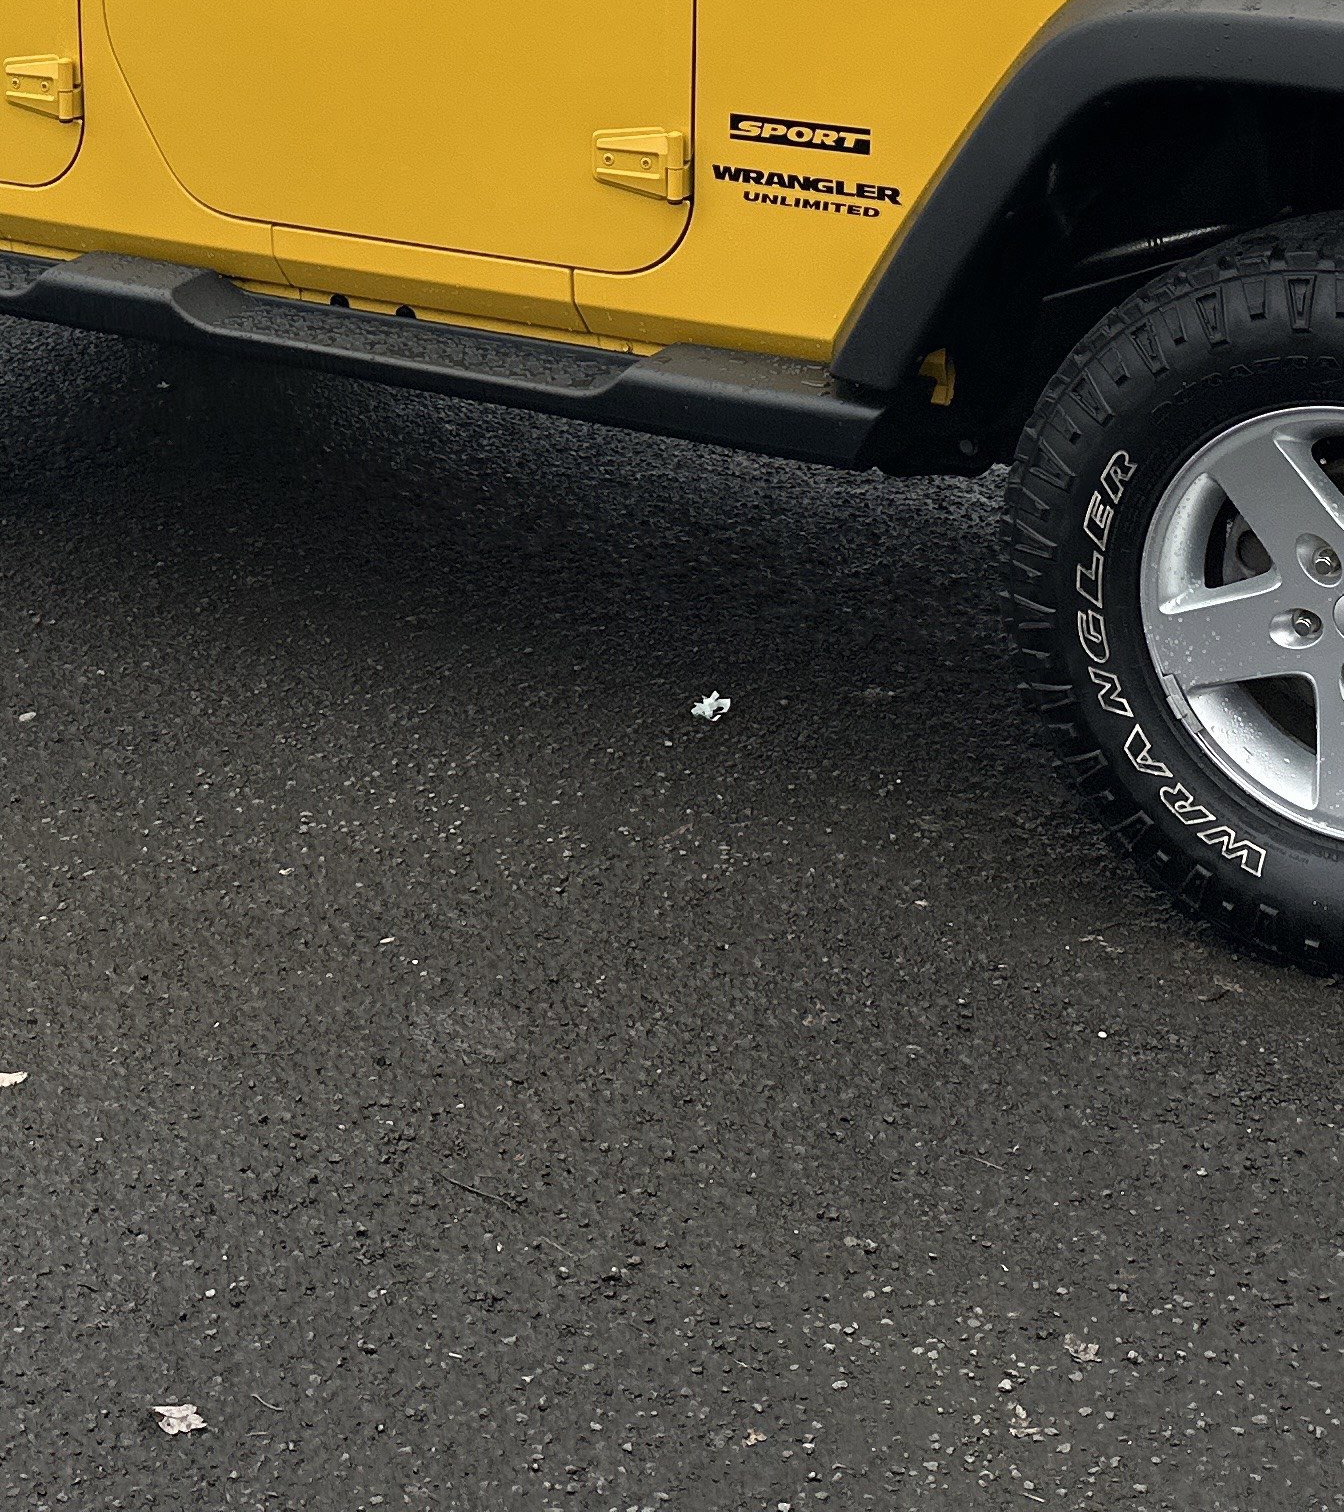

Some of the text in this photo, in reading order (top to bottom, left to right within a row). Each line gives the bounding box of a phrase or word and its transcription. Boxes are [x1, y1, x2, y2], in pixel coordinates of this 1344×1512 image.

[734, 118, 865, 150] SPORT
[712, 164, 903, 206] WRANGLER
[743, 191, 881, 218] UNLIMITED
[1076, 449, 1266, 876] WRANGLER
